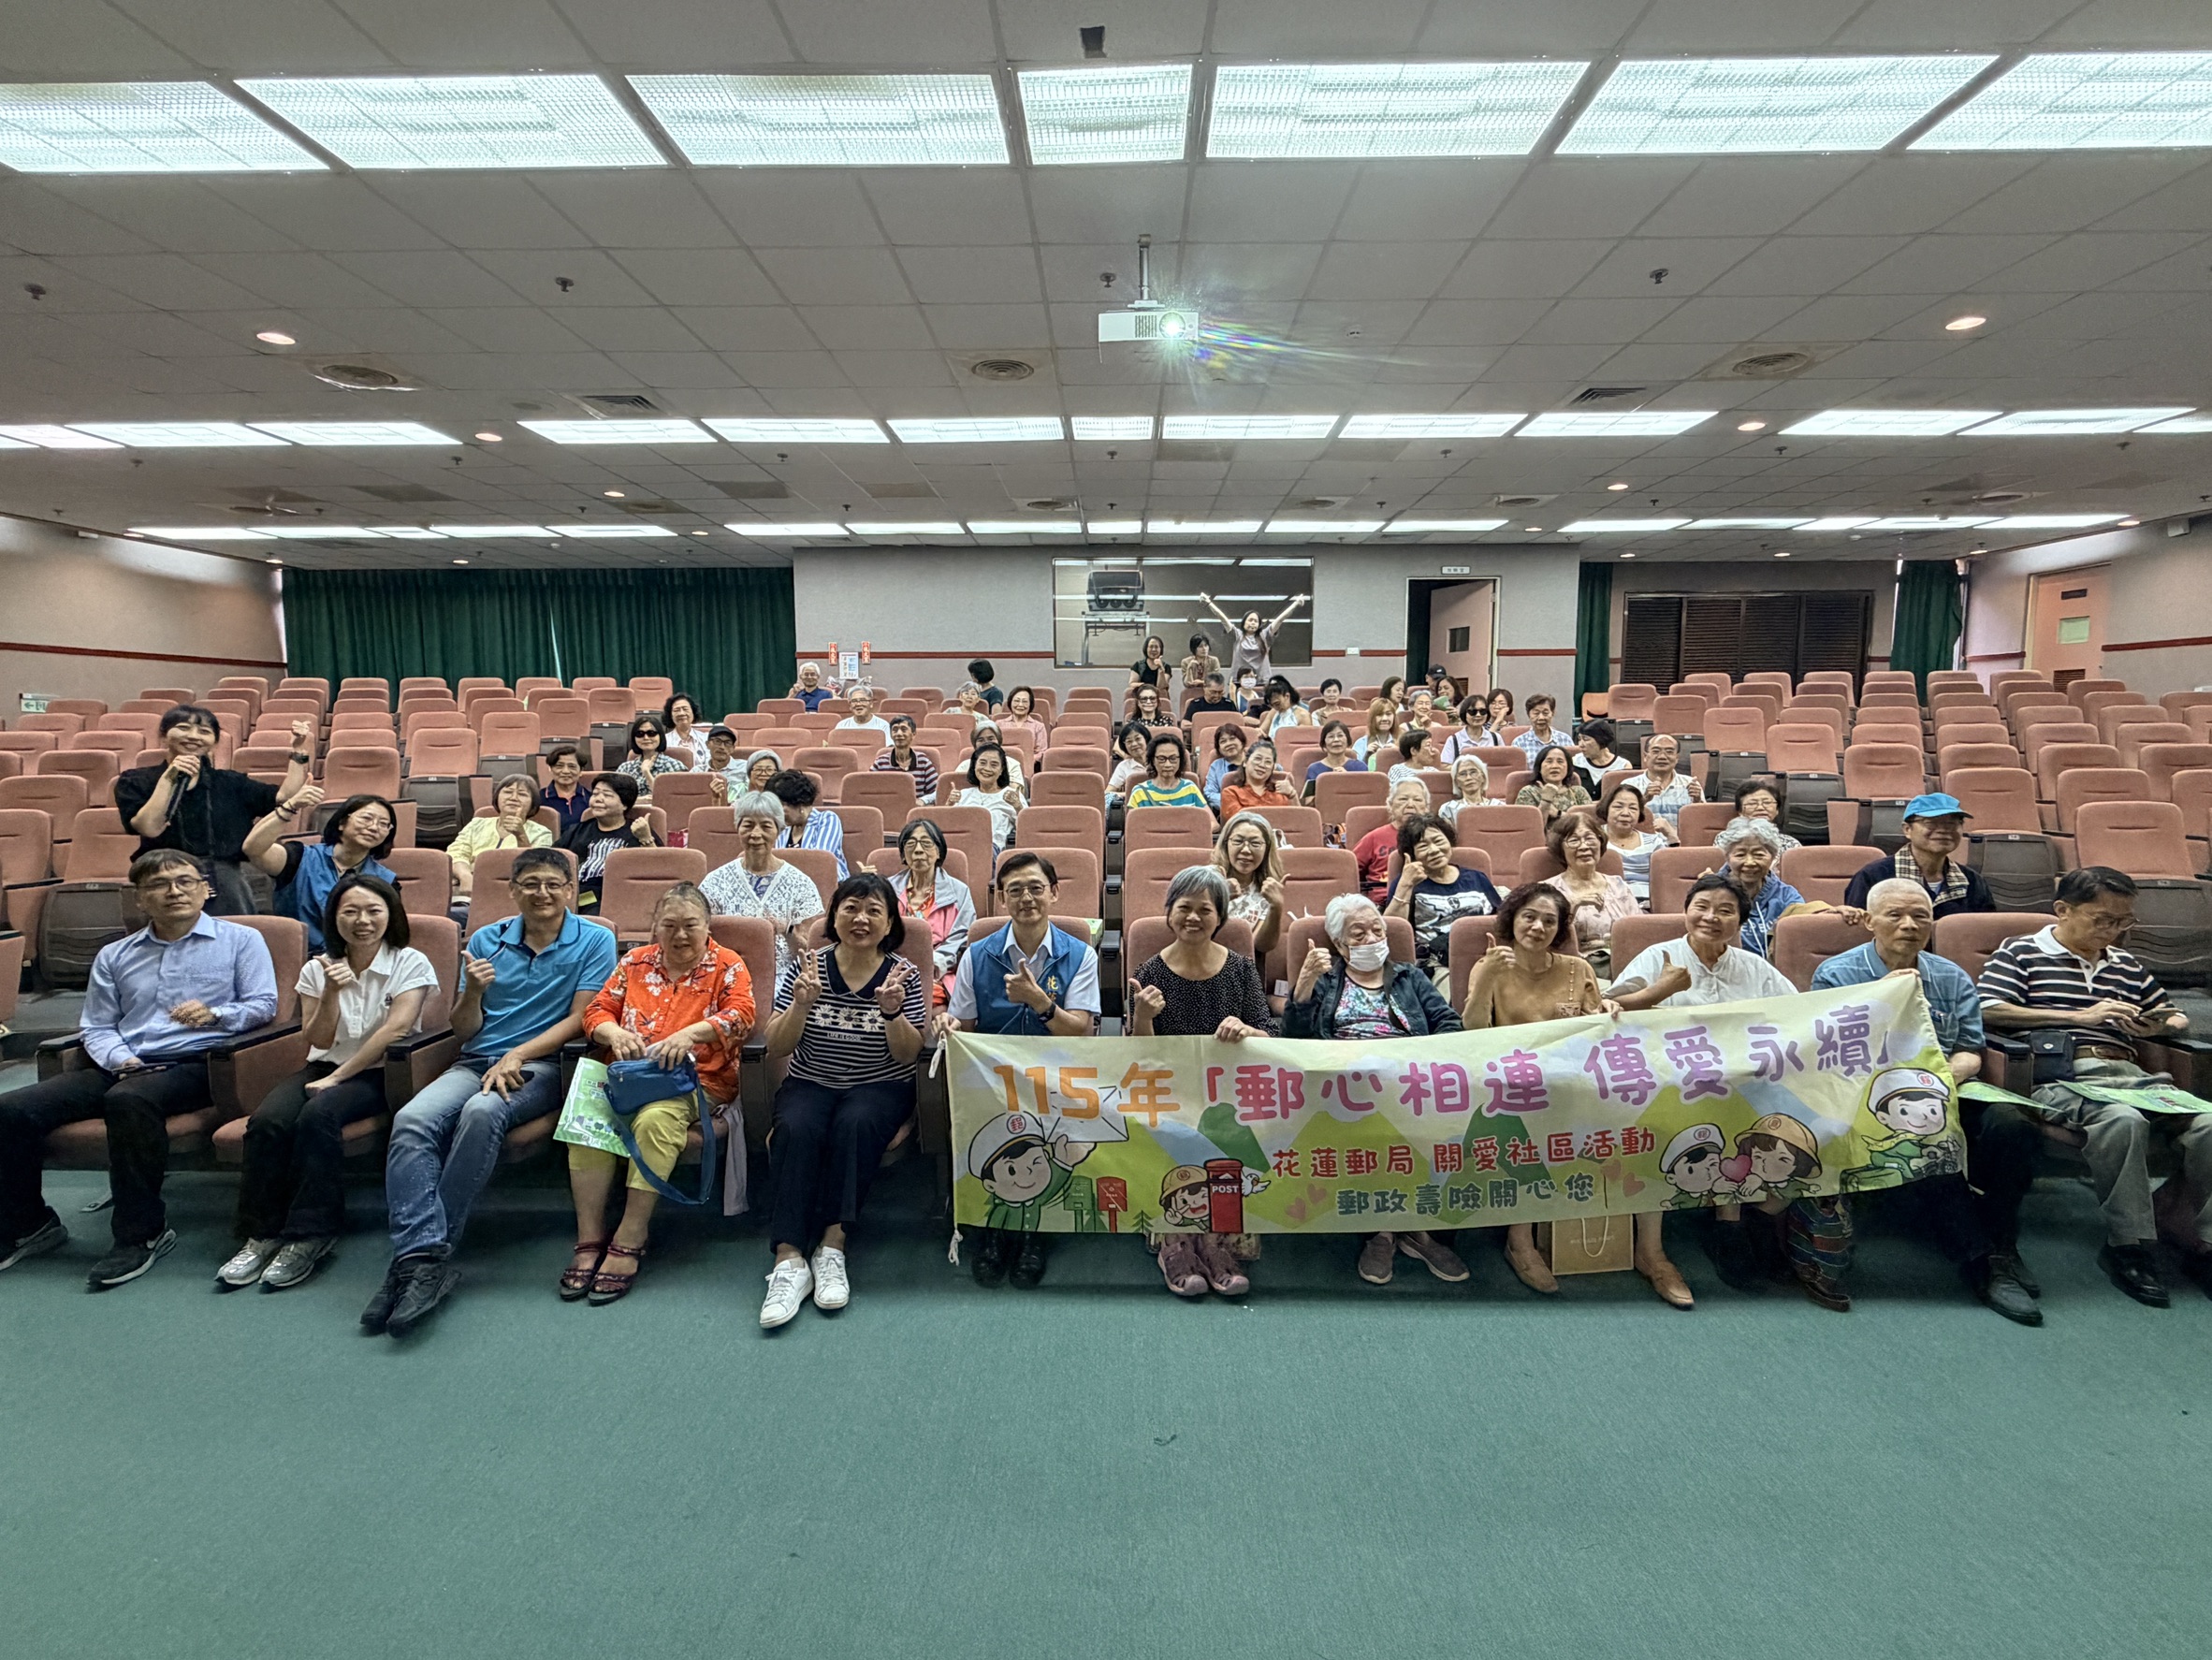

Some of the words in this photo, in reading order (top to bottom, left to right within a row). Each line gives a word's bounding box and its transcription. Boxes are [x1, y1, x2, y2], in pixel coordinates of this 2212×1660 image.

[1273, 1145, 1414, 1178] 花蓮郵局
[1433, 1127, 1655, 1172] 關愛社區活動
[1336, 1172, 1594, 1216] 郵政壽險關心您
